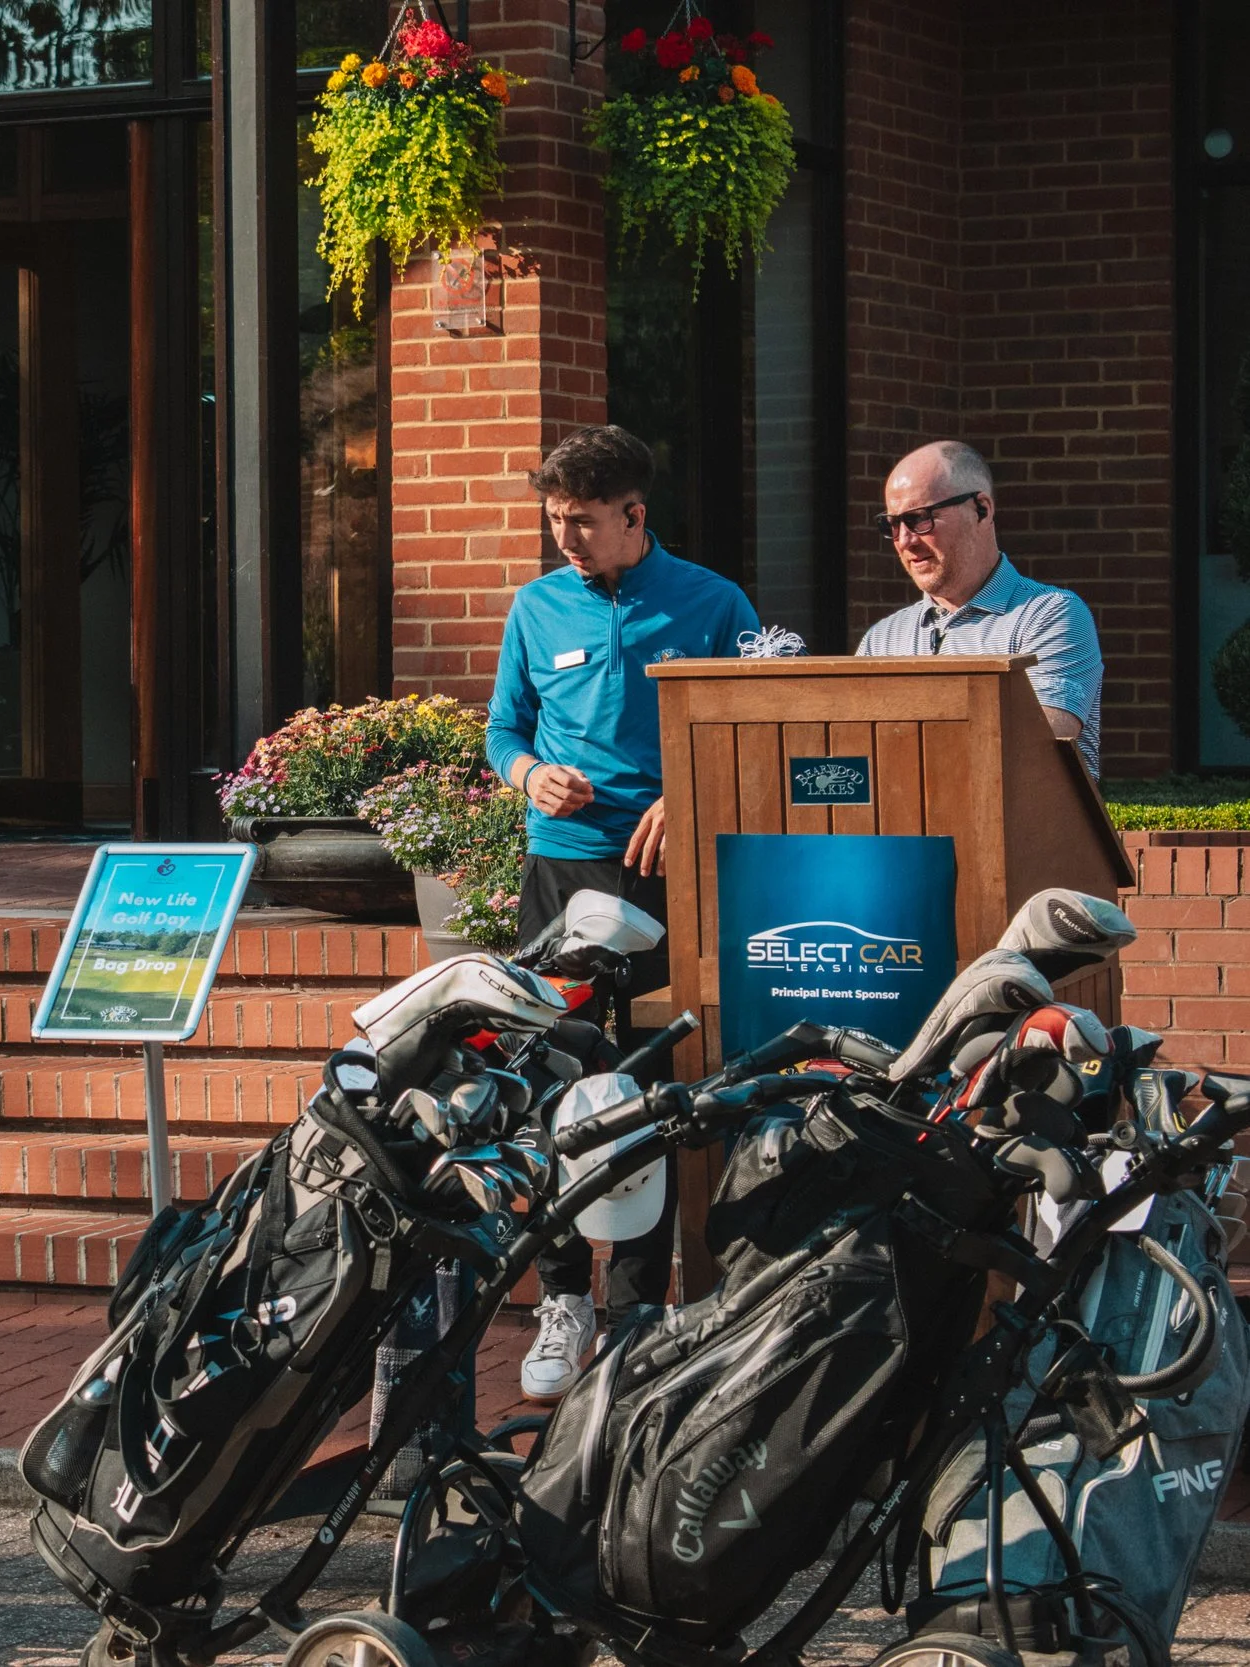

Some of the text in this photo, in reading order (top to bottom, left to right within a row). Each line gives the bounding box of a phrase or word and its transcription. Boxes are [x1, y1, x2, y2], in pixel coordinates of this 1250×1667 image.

[795, 763, 864, 787] BEARWOOD
[807, 782, 855, 796] LAKES
[119, 892, 198, 907] New Life
[112, 911, 191, 927] Golf Day
[747, 942, 923, 964] SELECT CAR
[92, 958, 177, 975] Bag Drop
[786, 963, 884, 974] LEASING
[479, 969, 540, 1009] cobra
[771, 987, 900, 1001] Principal Event Sponsor
[1153, 1459, 1224, 1503] PING
[330, 1480, 362, 1528] MOTOCADDY
[672, 1440, 768, 1562] Callaway
[869, 1480, 909, 1535] Ben Sayers
